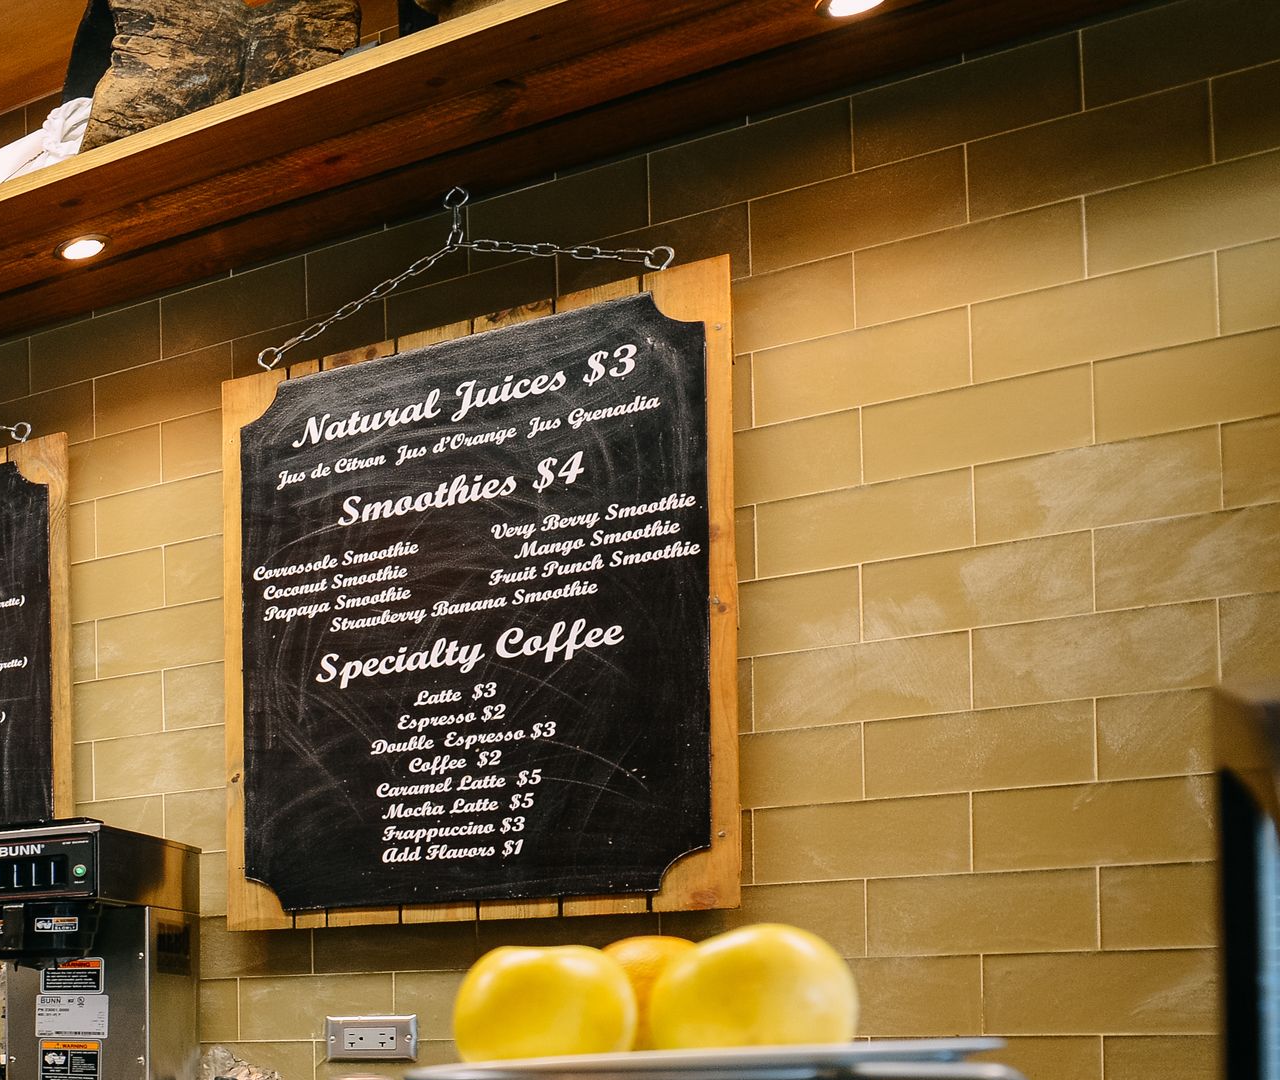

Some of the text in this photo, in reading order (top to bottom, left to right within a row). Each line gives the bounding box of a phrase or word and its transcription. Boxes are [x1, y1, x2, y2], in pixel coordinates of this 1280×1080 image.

[293, 344, 637, 448] Natural Juices $3
[277, 395, 661, 490] Jus de Citron Jus d'Orange Jus Grenadia
[338, 451, 584, 526] Smoothies $4
[491, 493, 696, 539] Very Berry Smoothie
[253, 541, 419, 581] Corrossole Smoothie
[514, 520, 680, 559] Mango Smoothie
[316, 618, 624, 689] Specialty Coffee
[413, 682, 497, 706] Latte $3
[370, 721, 556, 755] Double Espresso $3
[397, 704, 506, 732] Espresso $2
